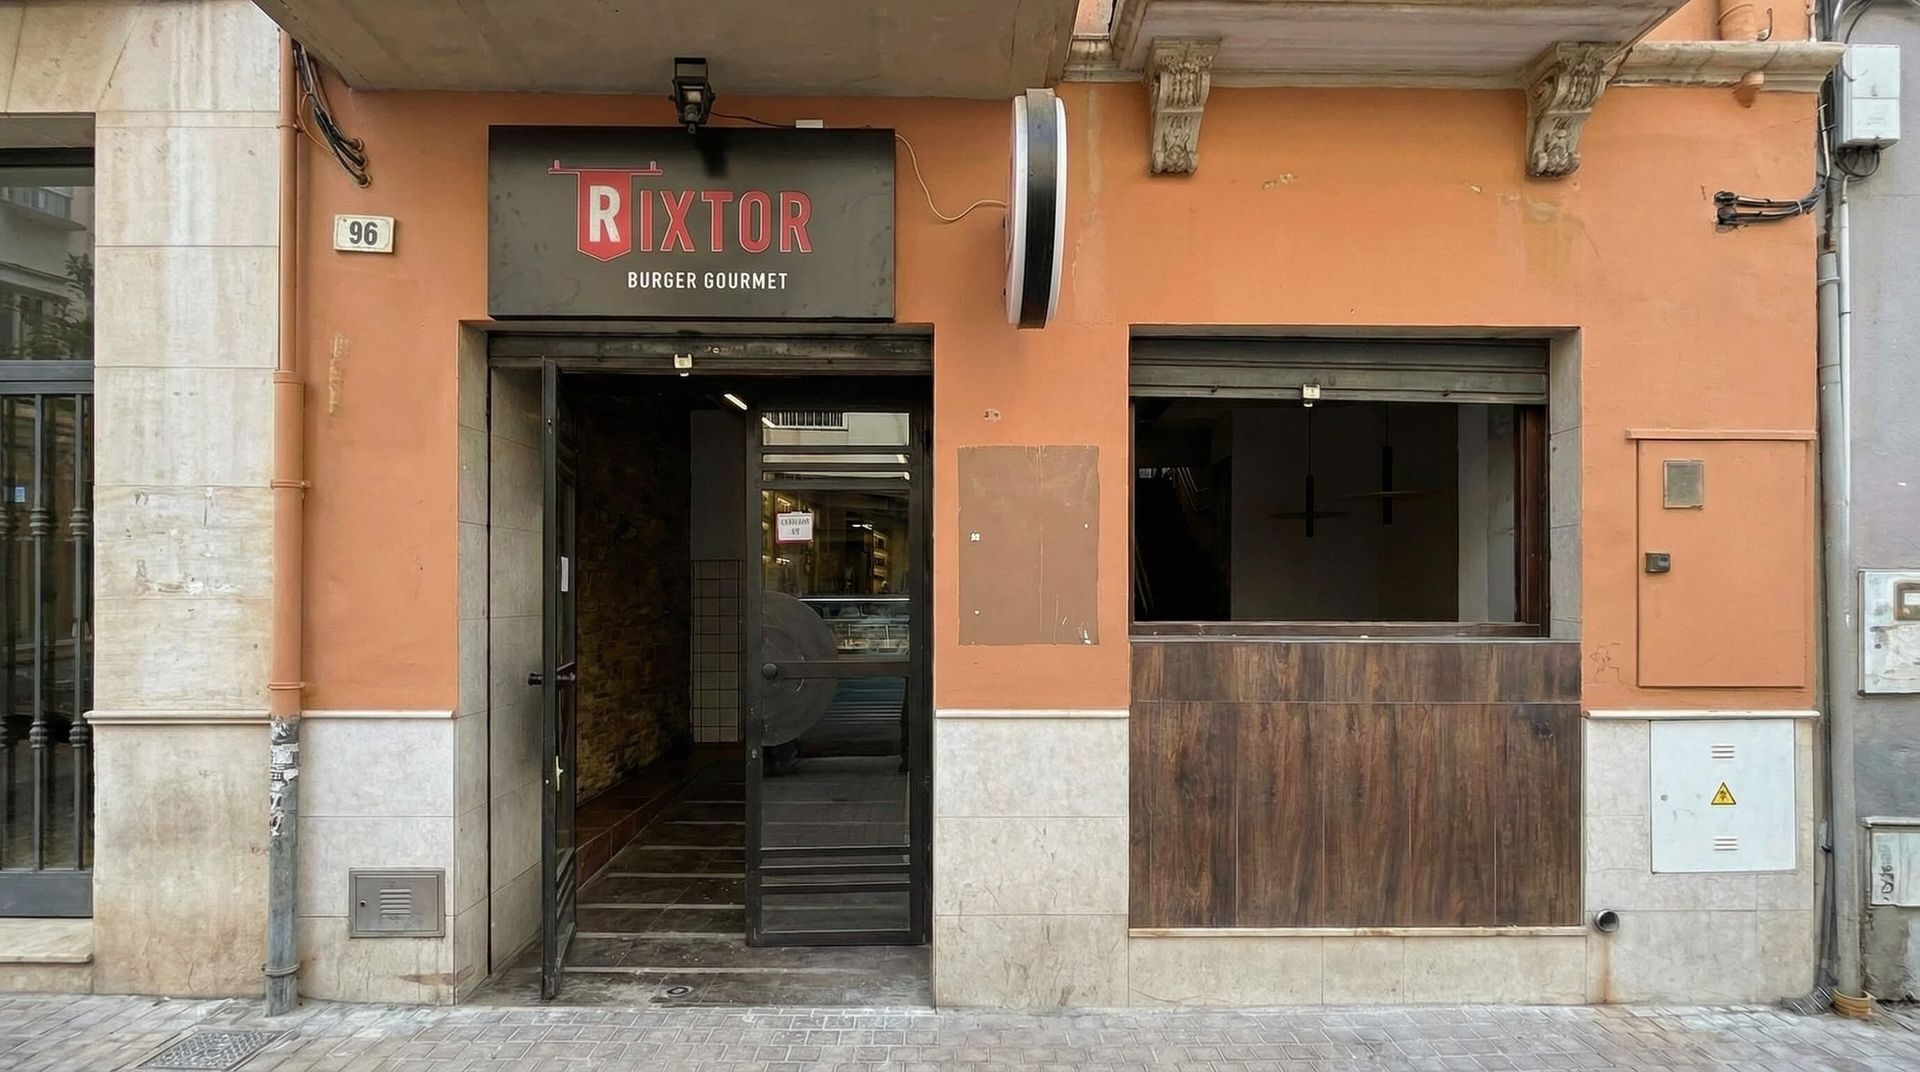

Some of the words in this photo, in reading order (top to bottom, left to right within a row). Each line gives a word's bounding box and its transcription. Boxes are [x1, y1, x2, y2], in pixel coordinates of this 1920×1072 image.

[588, 185, 813, 254] RIXTOR
[349, 221, 378, 245] 96
[627, 271, 697, 289] BURGER
[704, 272, 788, 289] GOURMET
